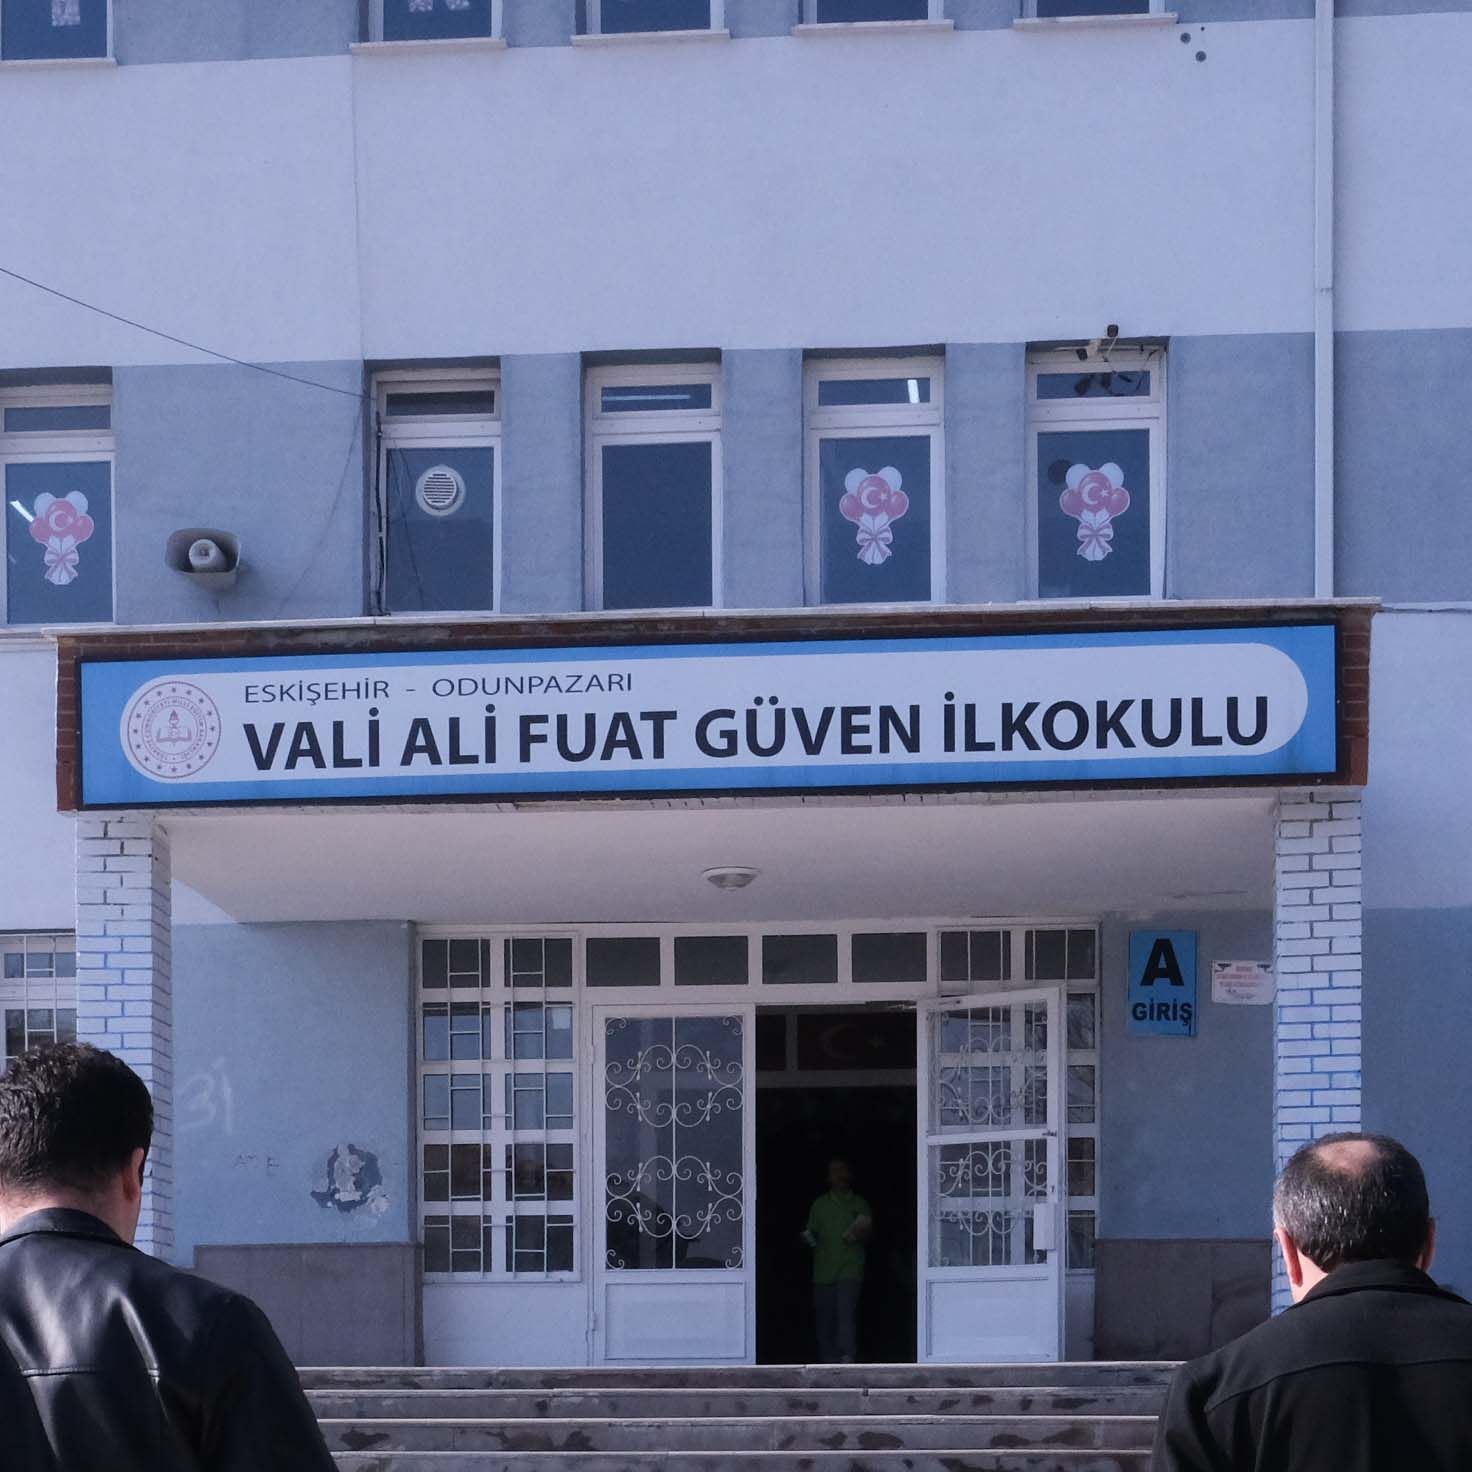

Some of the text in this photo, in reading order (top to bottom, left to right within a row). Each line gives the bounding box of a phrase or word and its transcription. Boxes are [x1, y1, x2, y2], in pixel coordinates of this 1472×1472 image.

[244, 678, 390, 705] ESKİŞEHİR
[432, 673, 633, 697] ODUNPAZARI
[243, 707, 381, 770] VALİ
[400, 703, 497, 767] ALİ
[519, 710, 678, 763] FUAT
[694, 696, 921, 758] GÜVEN
[943, 691, 1269, 753] İLKOKULU
[1140, 938, 1184, 986] A
[1132, 998, 1192, 1025] GİRİŞ
